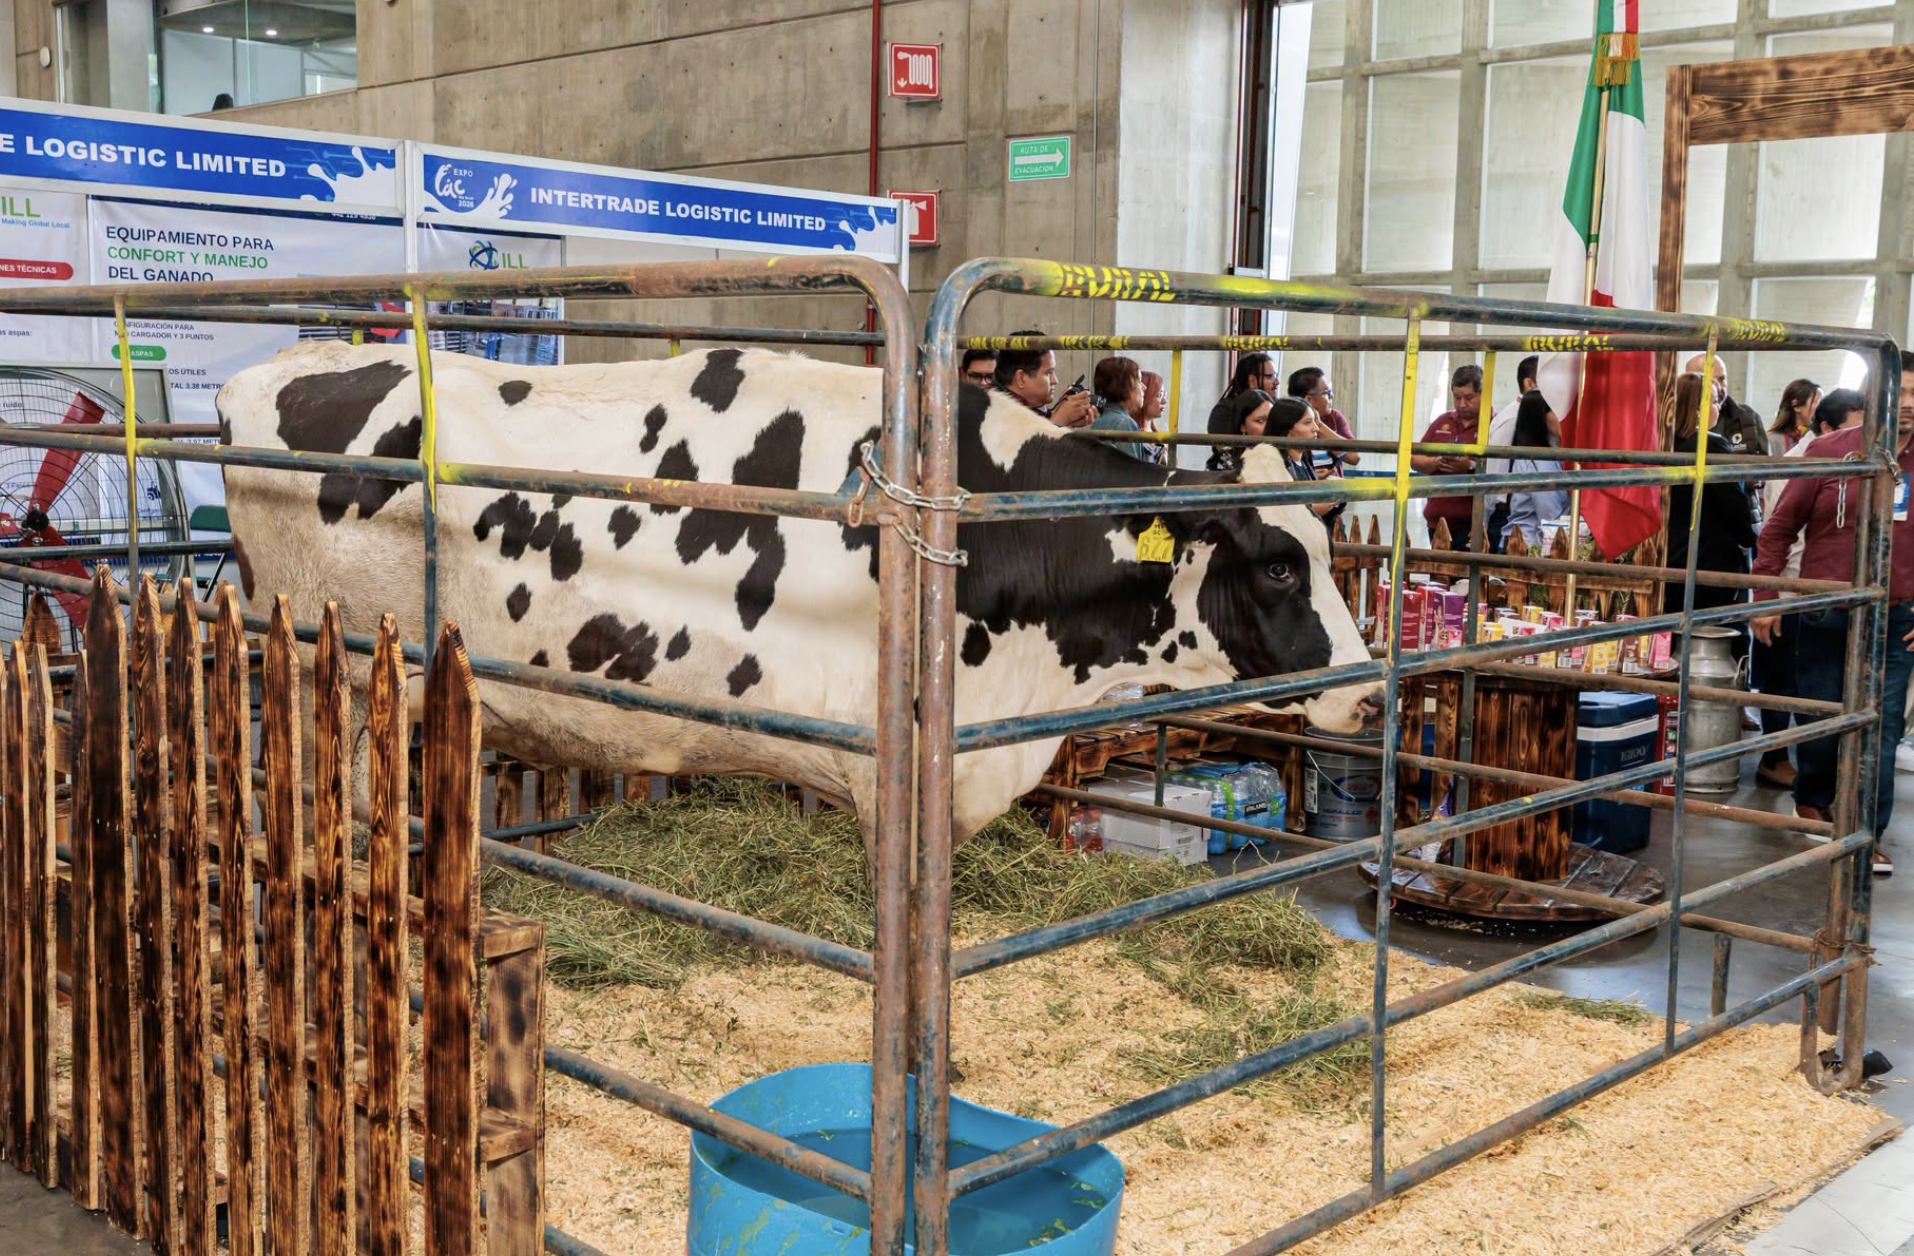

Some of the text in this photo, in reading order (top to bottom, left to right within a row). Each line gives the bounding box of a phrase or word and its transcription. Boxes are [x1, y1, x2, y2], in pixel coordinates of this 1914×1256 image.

[1020, 145, 1038, 153] RUTA
[25, 135, 167, 168] LOGISTIC
[176, 151, 286, 177] LIMITED
[453, 168, 474, 177] EXPO
[530, 187, 826, 231] INTERTRADE LOGISTIC LIMITED
[1, 218, 70, 229] Making Global Local
[106, 226, 274, 251] EQUIPAMIENTO PARA
[107, 246, 268, 270] CONFORT Y MANEJO
[17, 264, 57, 274] TÉCNICAS
[108, 265, 213, 283] DEL GANADO
[174, 323, 194, 331] PARA
[130, 331, 171, 339] CARGADOR
[185, 333, 214, 341] PUNTOS
[180, 367, 207, 376] ÚTILES
